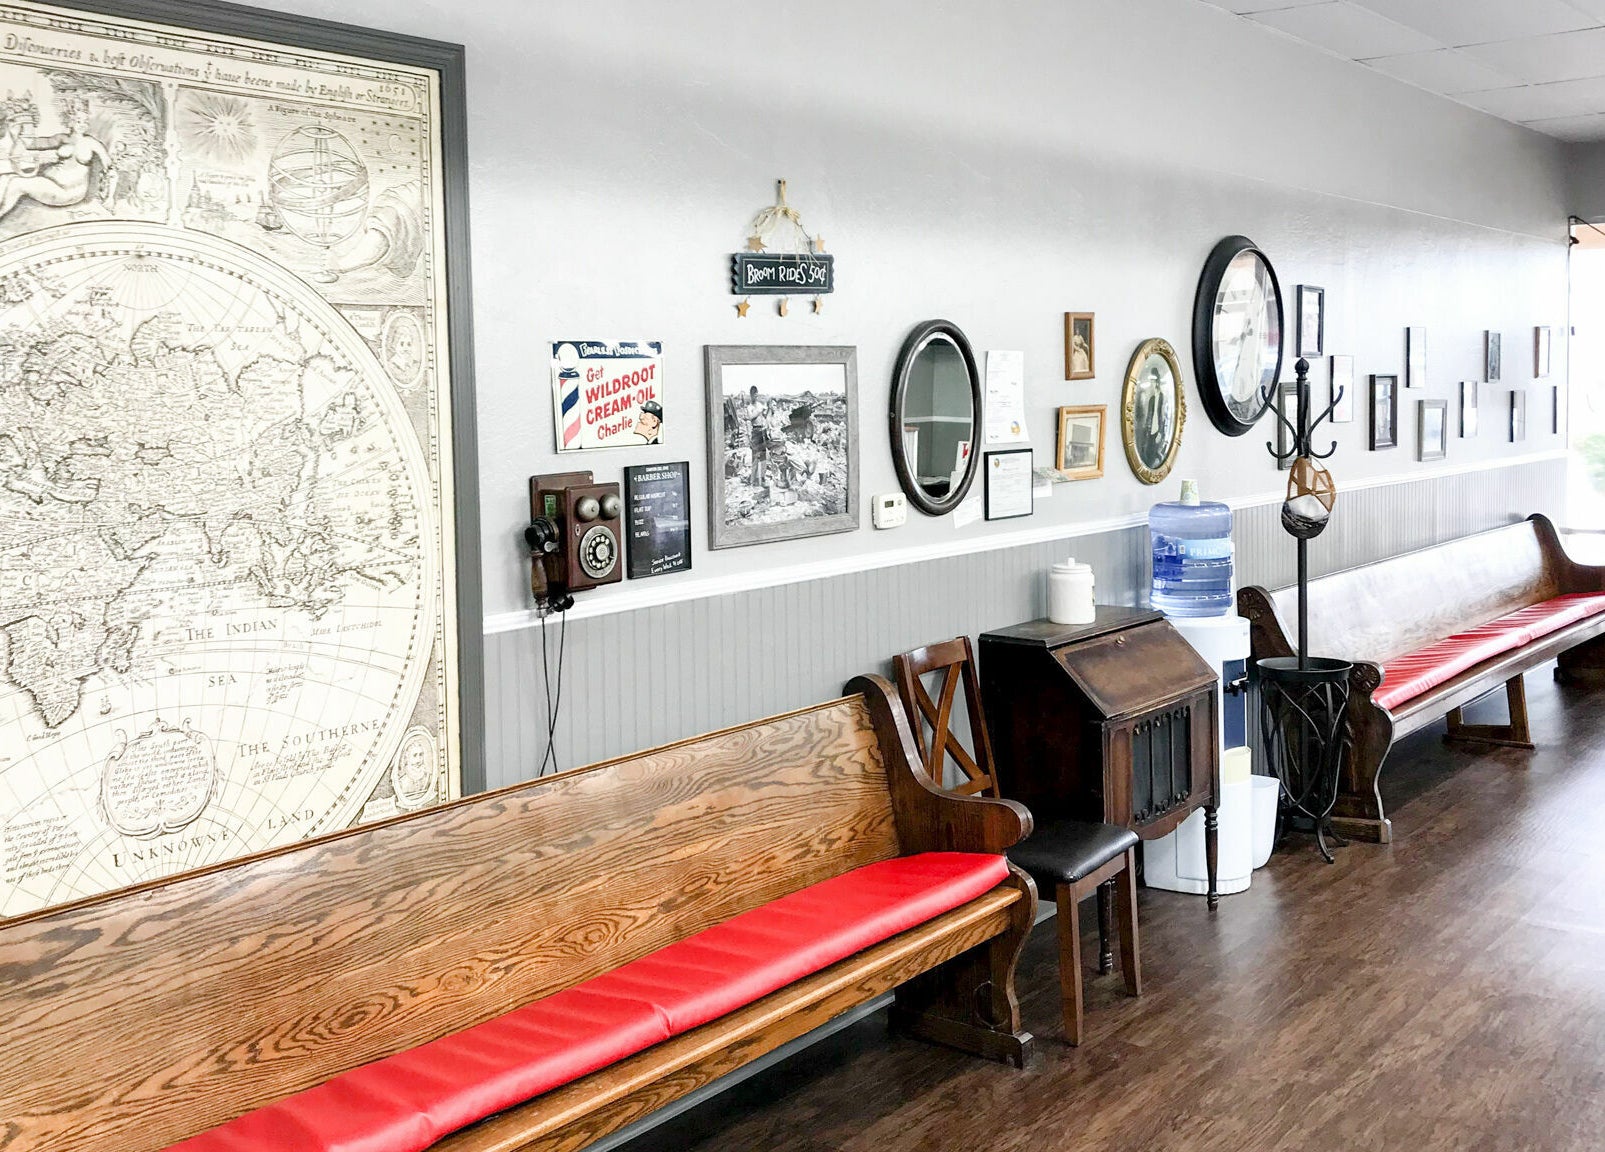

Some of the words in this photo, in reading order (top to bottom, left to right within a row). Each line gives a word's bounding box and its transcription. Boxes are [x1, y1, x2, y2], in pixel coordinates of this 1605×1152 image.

[746, 264, 776, 285] BROOM
[779, 263, 808, 285] RIDES
[586, 365, 604, 383] Get
[586, 364, 656, 404] WILDROOT
[597, 416, 633, 440] Charlie
[637, 472, 661, 482] BARBER
[661, 470, 678, 480] SHOP
[186, 627, 215, 641] THE
[226, 618, 279, 637] INDIAN
[208, 674, 238, 689] SEA
[238, 742, 271, 758] THE
[281, 719, 381, 749] SOUTHERNE
[267, 809, 314, 829] LAND
[113, 829, 229, 868] UNKNOWNE
